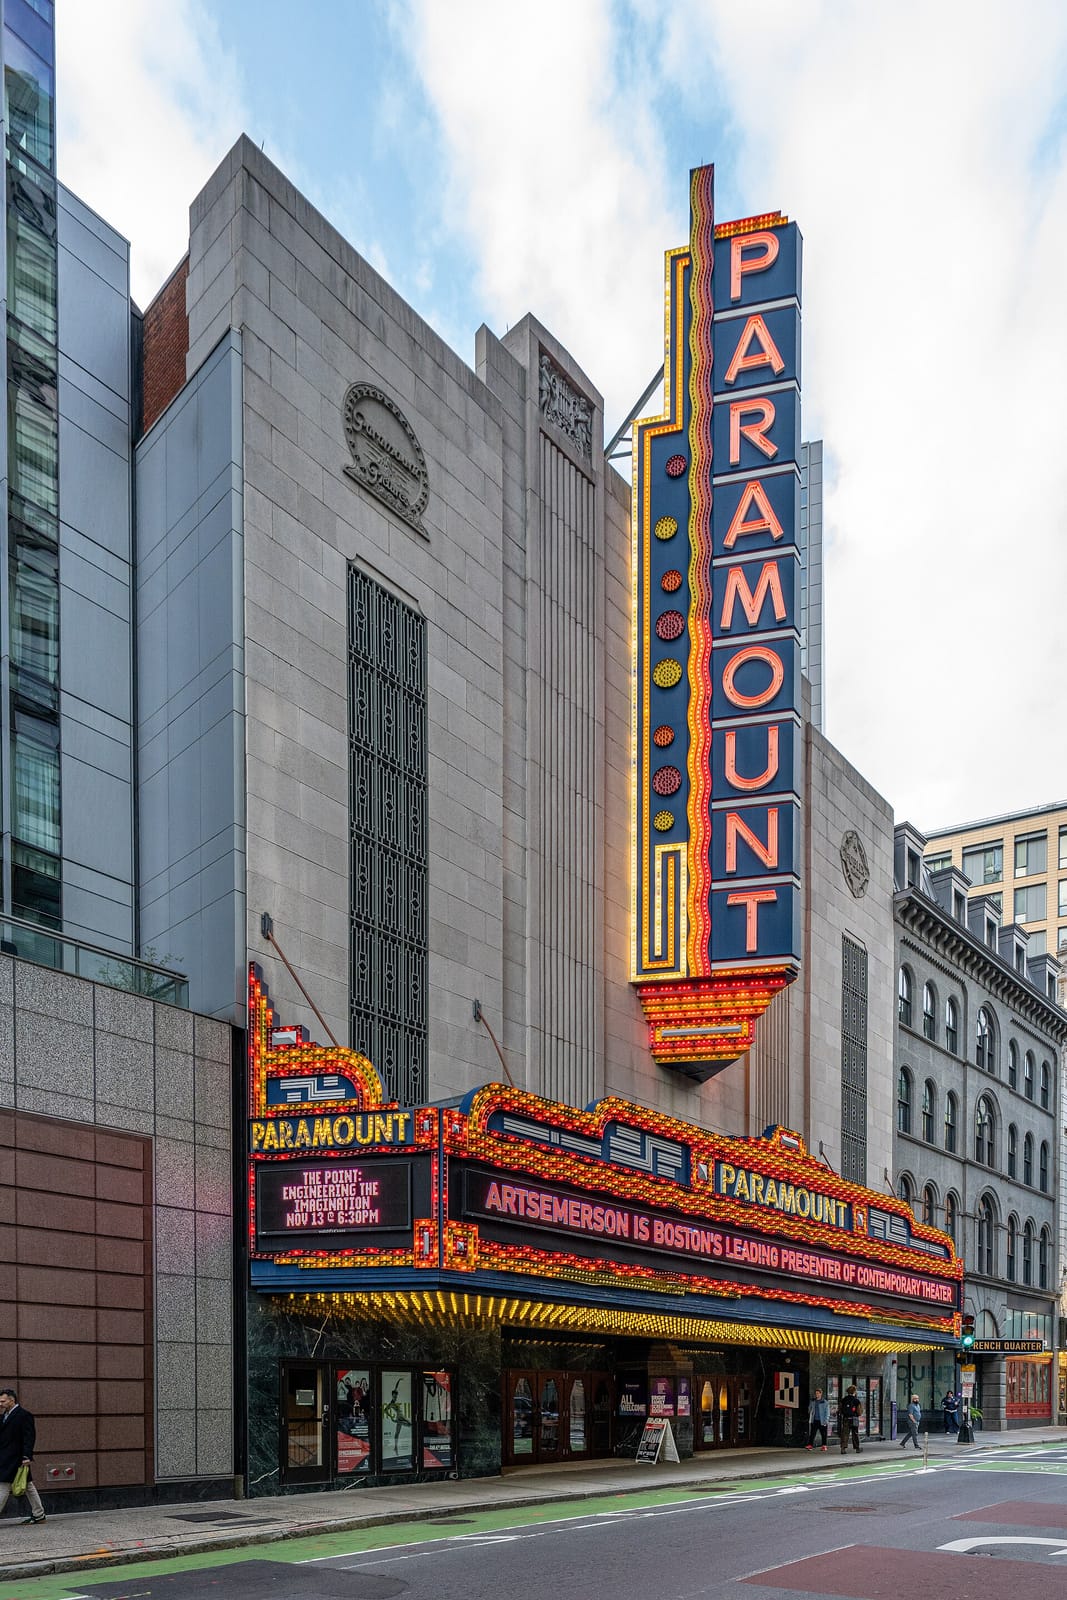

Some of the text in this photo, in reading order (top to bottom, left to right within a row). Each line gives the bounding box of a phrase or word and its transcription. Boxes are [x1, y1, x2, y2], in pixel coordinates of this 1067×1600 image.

[720, 231, 786, 952] PARAMOUNT
[252, 1112, 410, 1150] PARAMOUNT
[303, 1169, 362, 1185] THE POINT:
[282, 1182, 379, 1200] ENGINEERING THE
[720, 1163, 848, 1228] PARAMOUNT
[294, 1196, 370, 1213] IMAGINATION
[286, 1213, 308, 1227] NOV
[311, 1212, 324, 1225] 13
[337, 1209, 379, 1224] 6:30PM
[485, 1182, 952, 1302] ARTSEMERSON IS BOSTON'S LEADING PRESENTER OF CONTEMPORARY THEATER
[972, 1340, 1042, 1351] RENCH QUARTER
[621, 1394, 634, 1405] ALL
[621, 1403, 647, 1412] WELCOME
